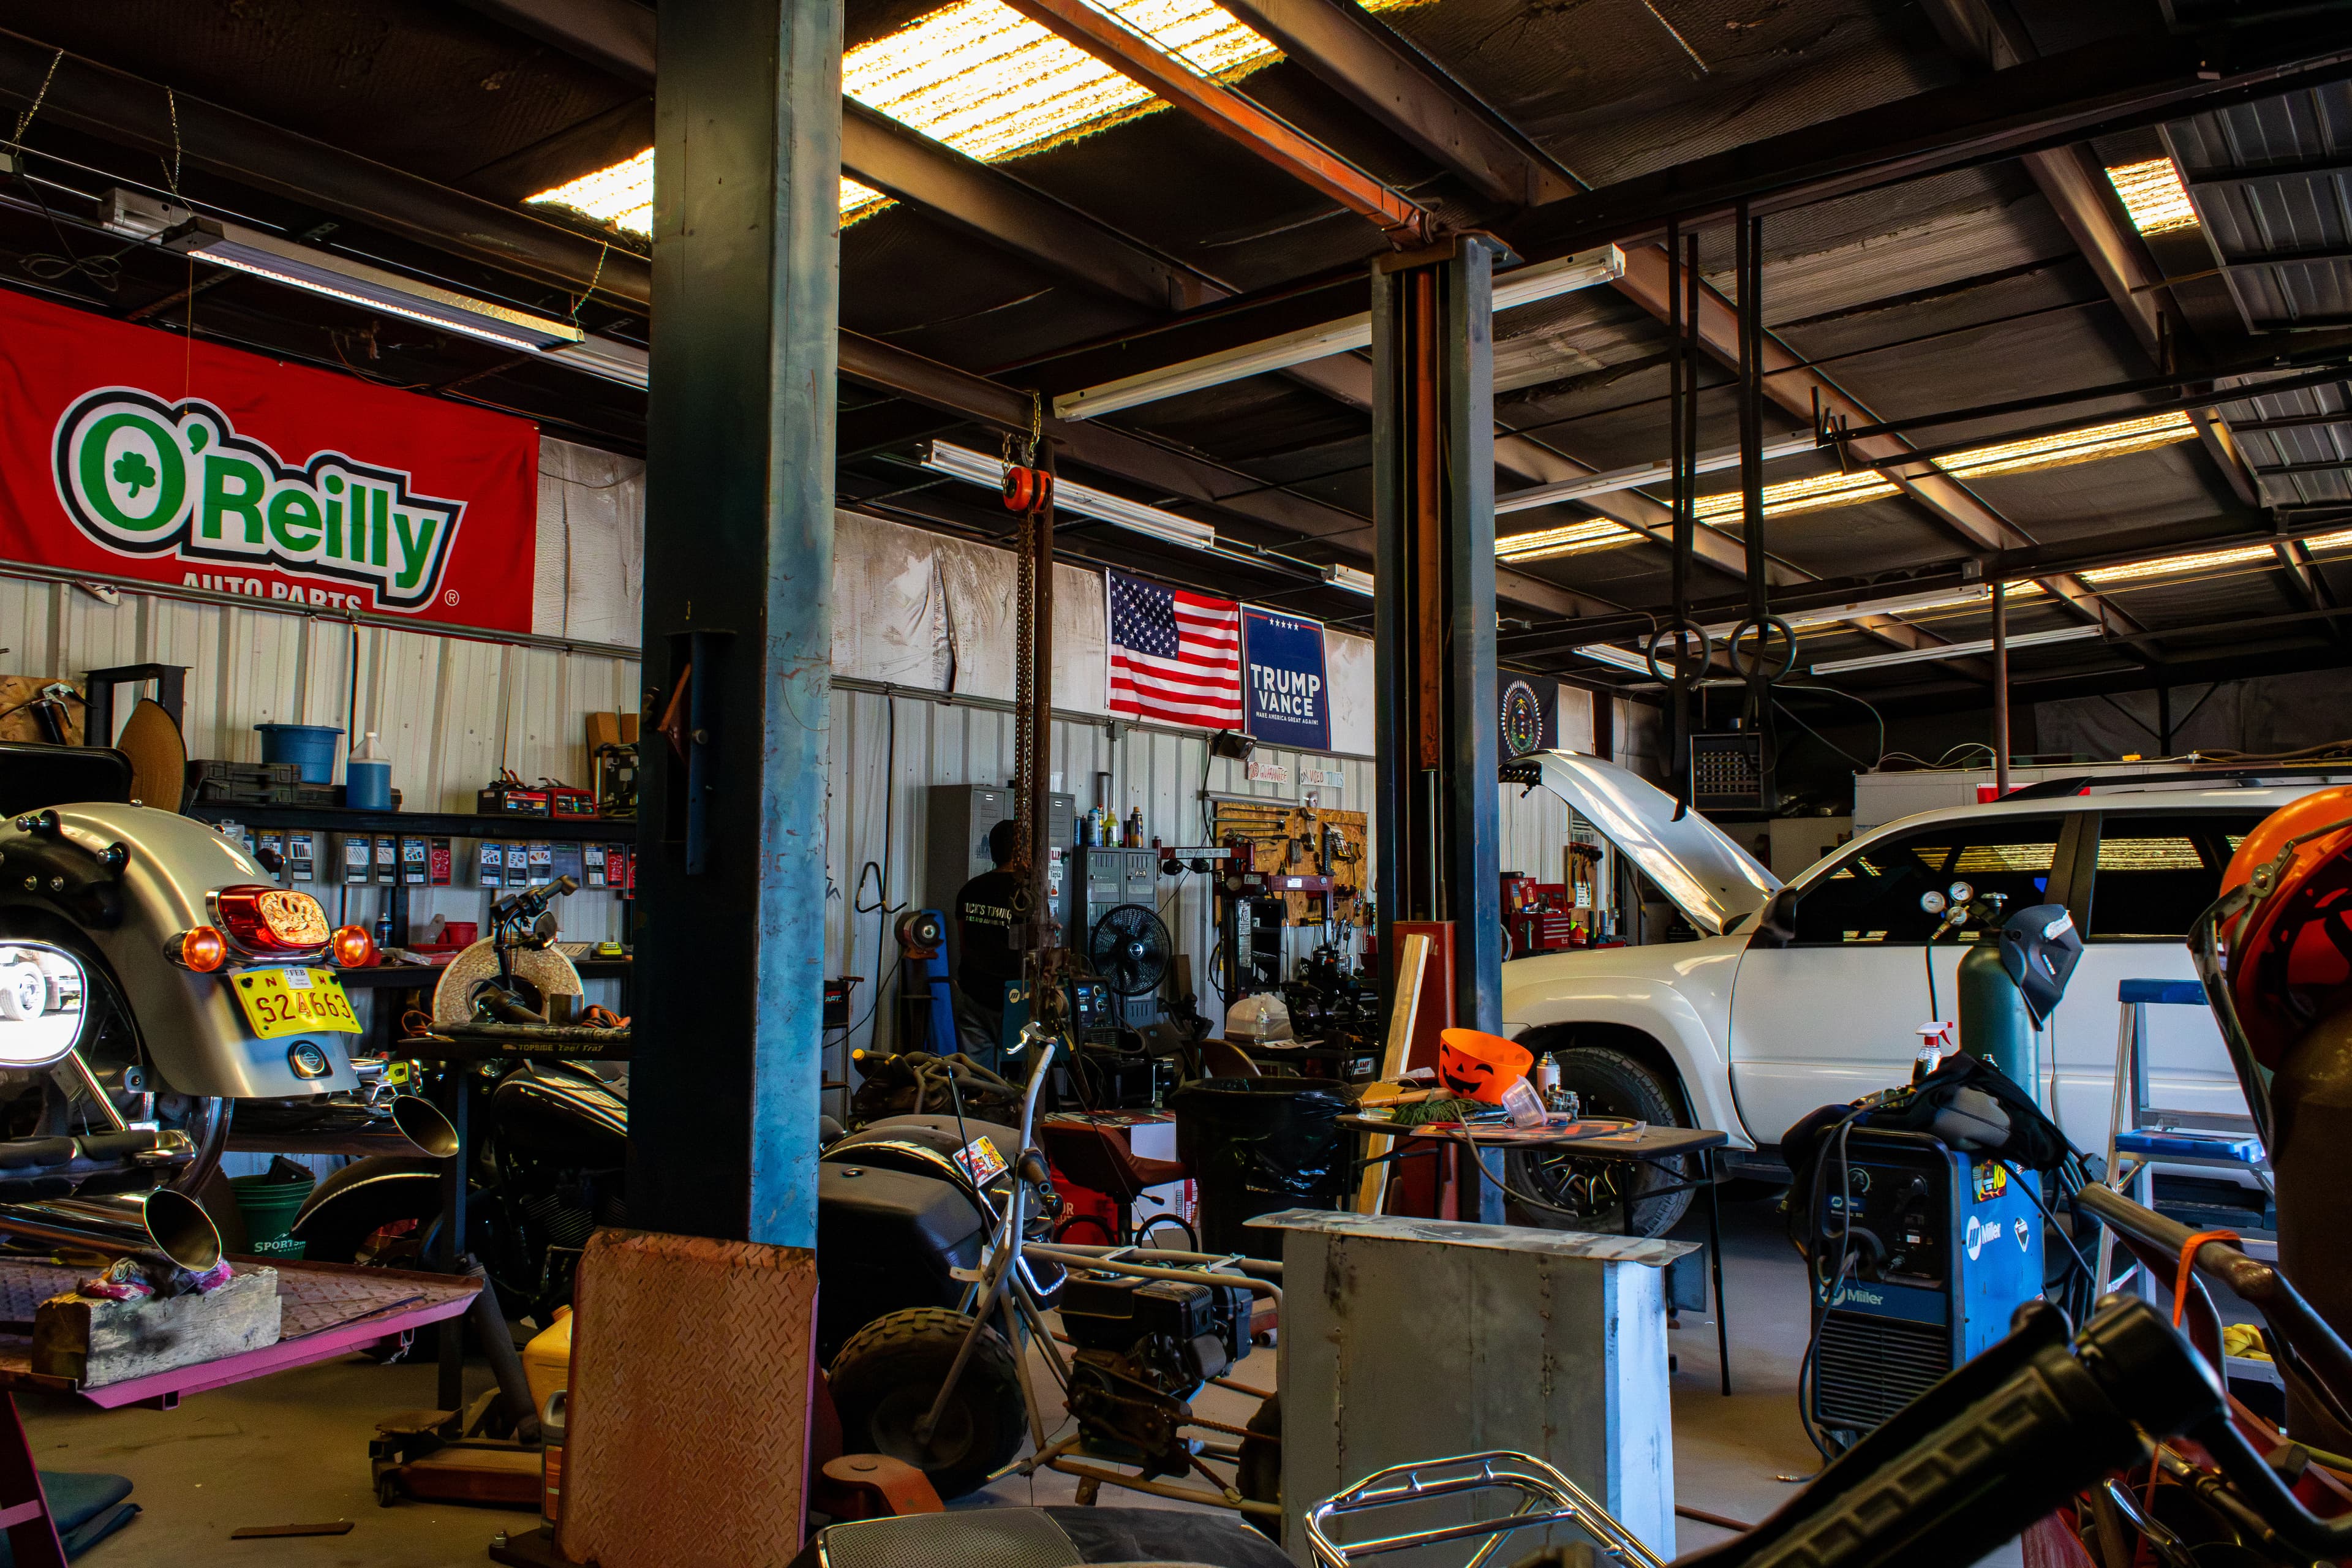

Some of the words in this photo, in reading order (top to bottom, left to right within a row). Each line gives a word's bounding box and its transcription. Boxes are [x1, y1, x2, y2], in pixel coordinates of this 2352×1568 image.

[80, 413, 437, 589] O'Reilly
[1250, 663, 1321, 697] TRUMP
[1259, 690, 1313, 717] VANCE
[1268, 713, 1287, 722] AMERICA
[1981, 1221, 2001, 1244] Miller
[1847, 1288, 1883, 1305] Miller
